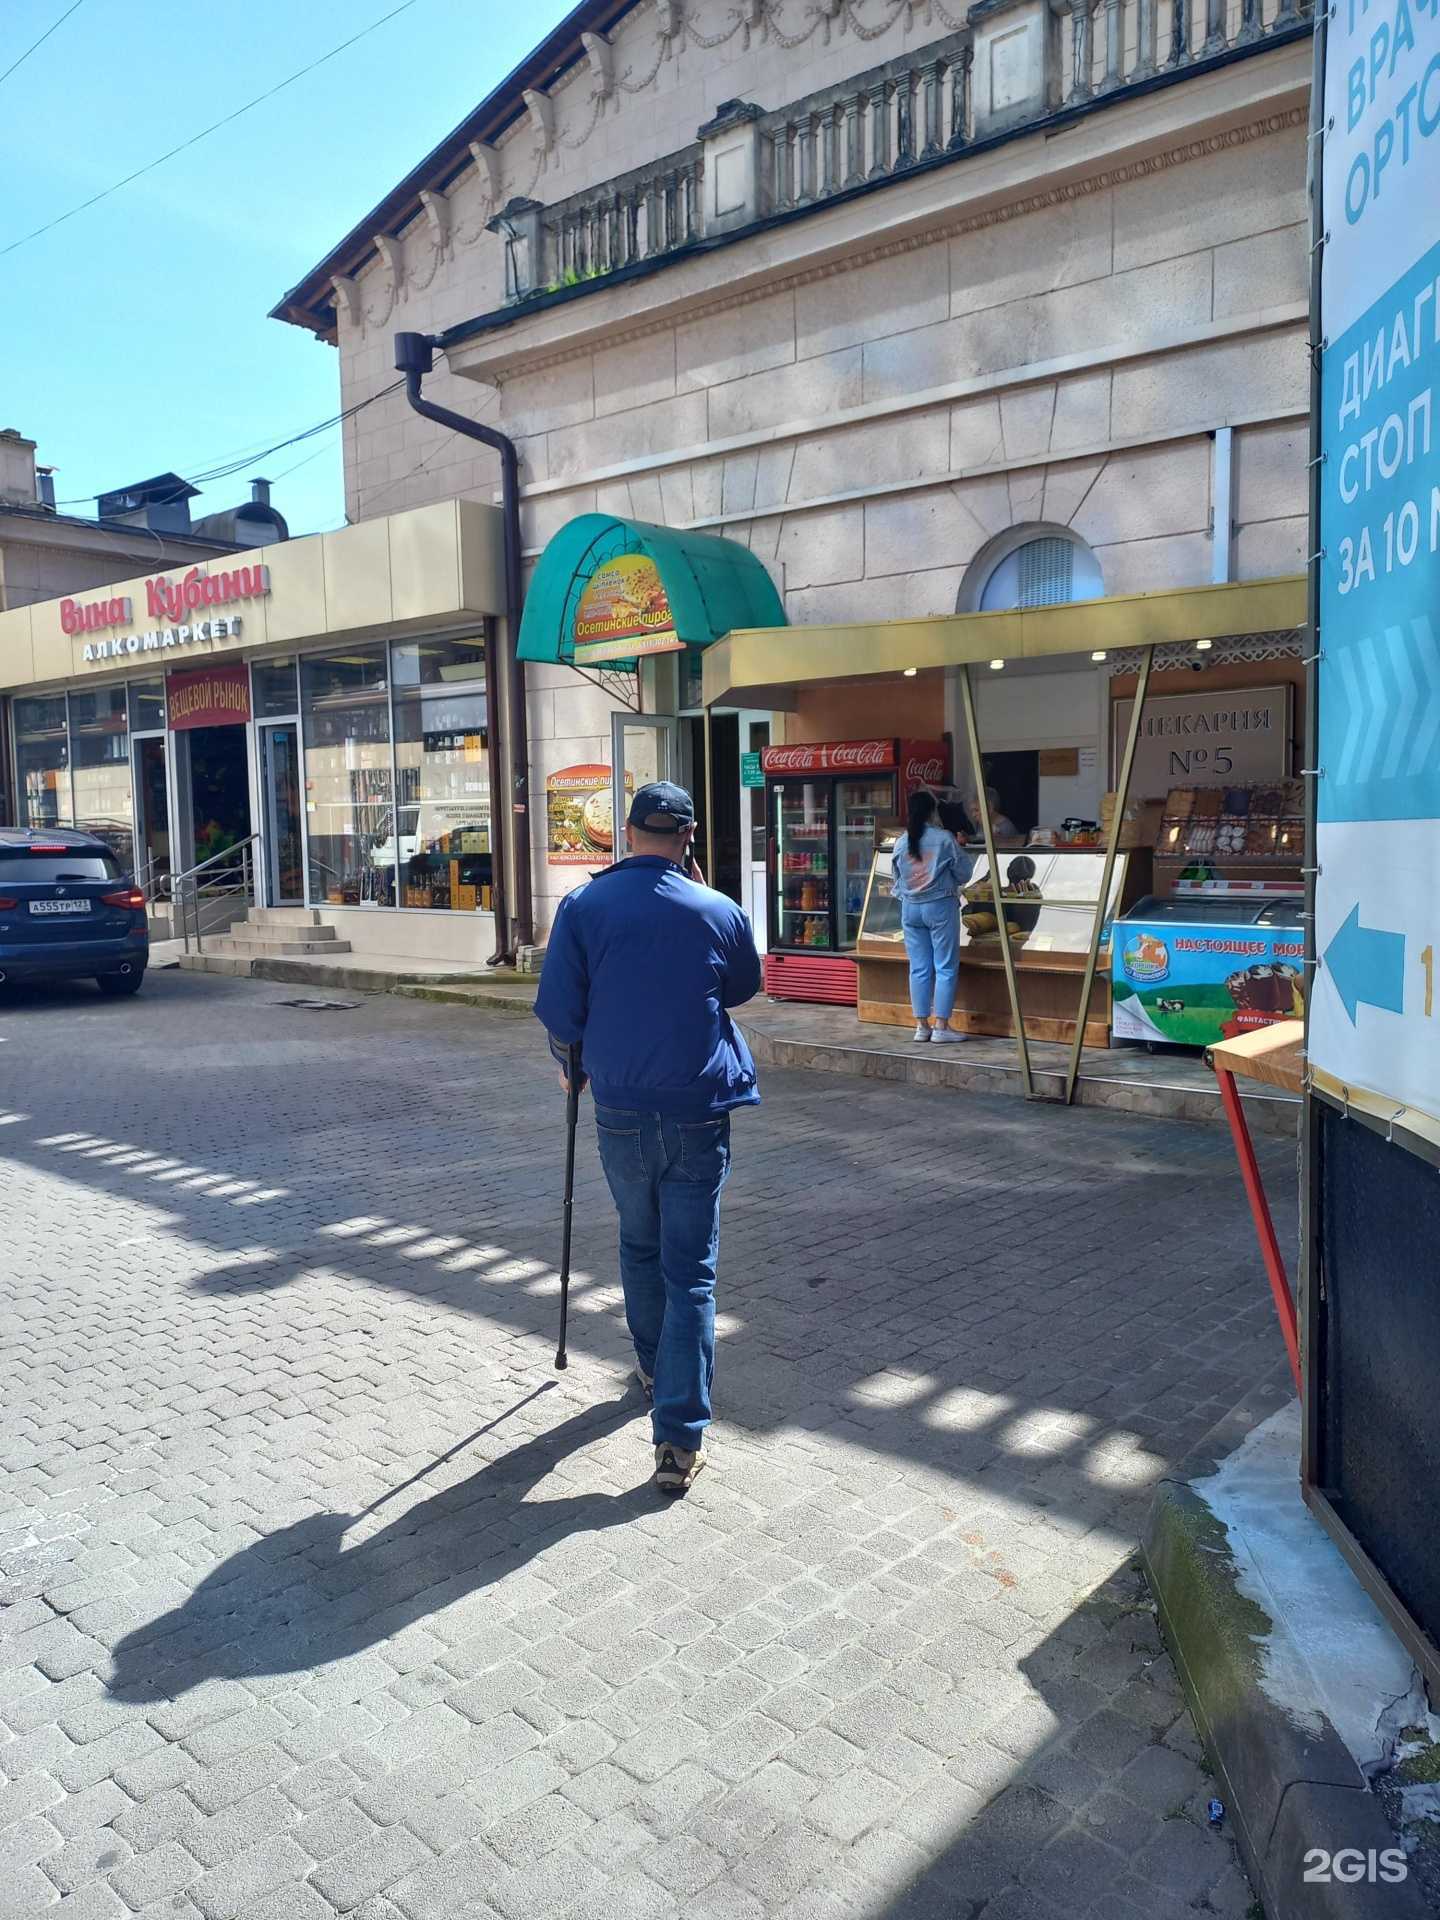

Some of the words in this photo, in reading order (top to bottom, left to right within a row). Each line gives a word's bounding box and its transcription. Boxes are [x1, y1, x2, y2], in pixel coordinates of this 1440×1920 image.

[1347, 0, 1438, 134] ВРА
[1339, 275, 1440, 432] ДИАГ
[1339, 388, 1431, 504] СТОП
[1338, 526, 1375, 594] ЗА
[1383, 500, 1419, 573] 10
[60, 597, 132, 634] Вина
[145, 565, 268, 623] Кубани
[82, 615, 241, 661] АЛКОМАРКЕТ
[577, 614, 640, 636] Осетинские
[169, 677, 212, 721] ВЕЩЕВОЙ
[213, 680, 248, 713] РЫНОК
[764, 746, 816, 769] Coca-Cola
[831, 741, 888, 766] Coca-Cola
[1175, 938, 1266, 957] НАСТОЯЩЕЕ
